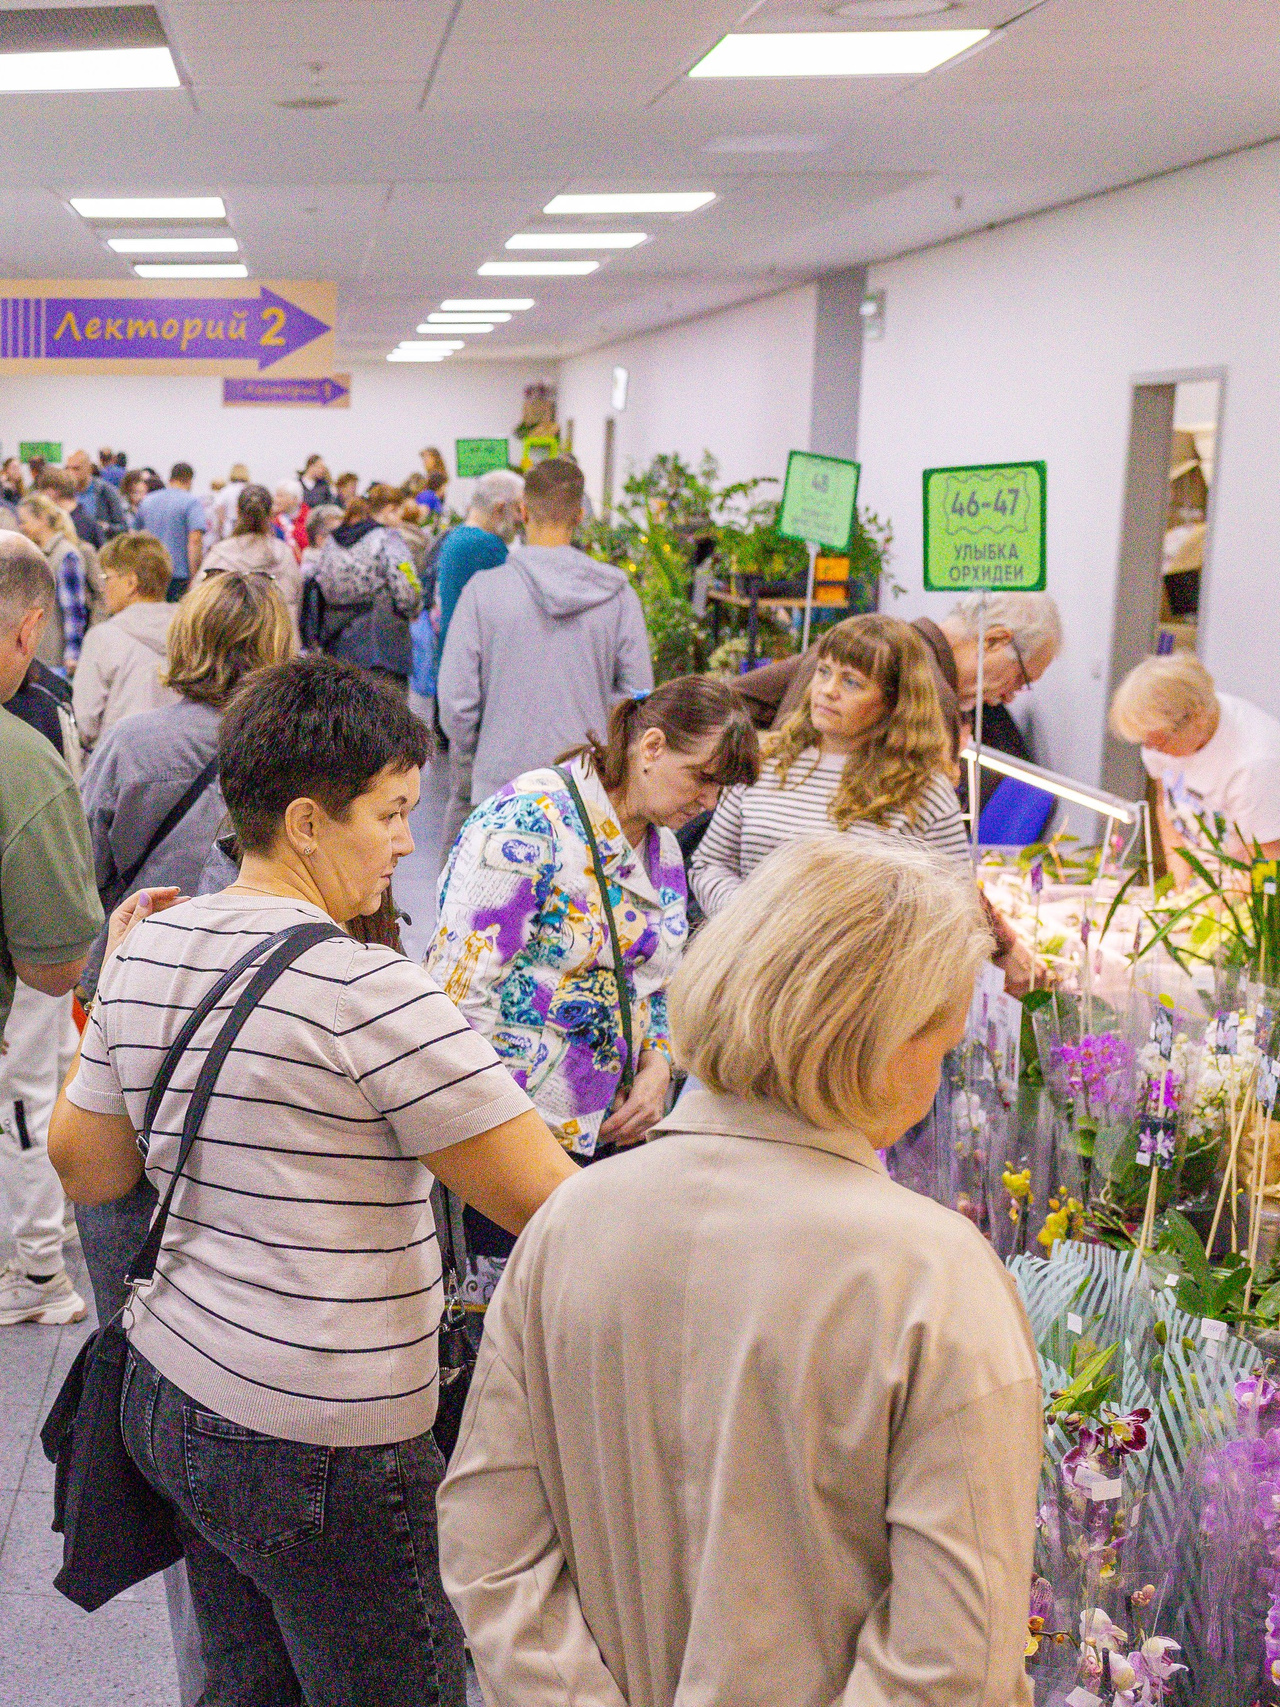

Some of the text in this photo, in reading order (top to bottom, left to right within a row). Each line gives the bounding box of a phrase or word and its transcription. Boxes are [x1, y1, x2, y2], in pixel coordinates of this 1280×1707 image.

[53, 307, 287, 351] Лекторий 2
[950, 488, 1020, 517] 46-47
[954, 543, 1019, 563] УЛЫБКА
[948, 565, 1025, 584] ОРХИДЕИ
